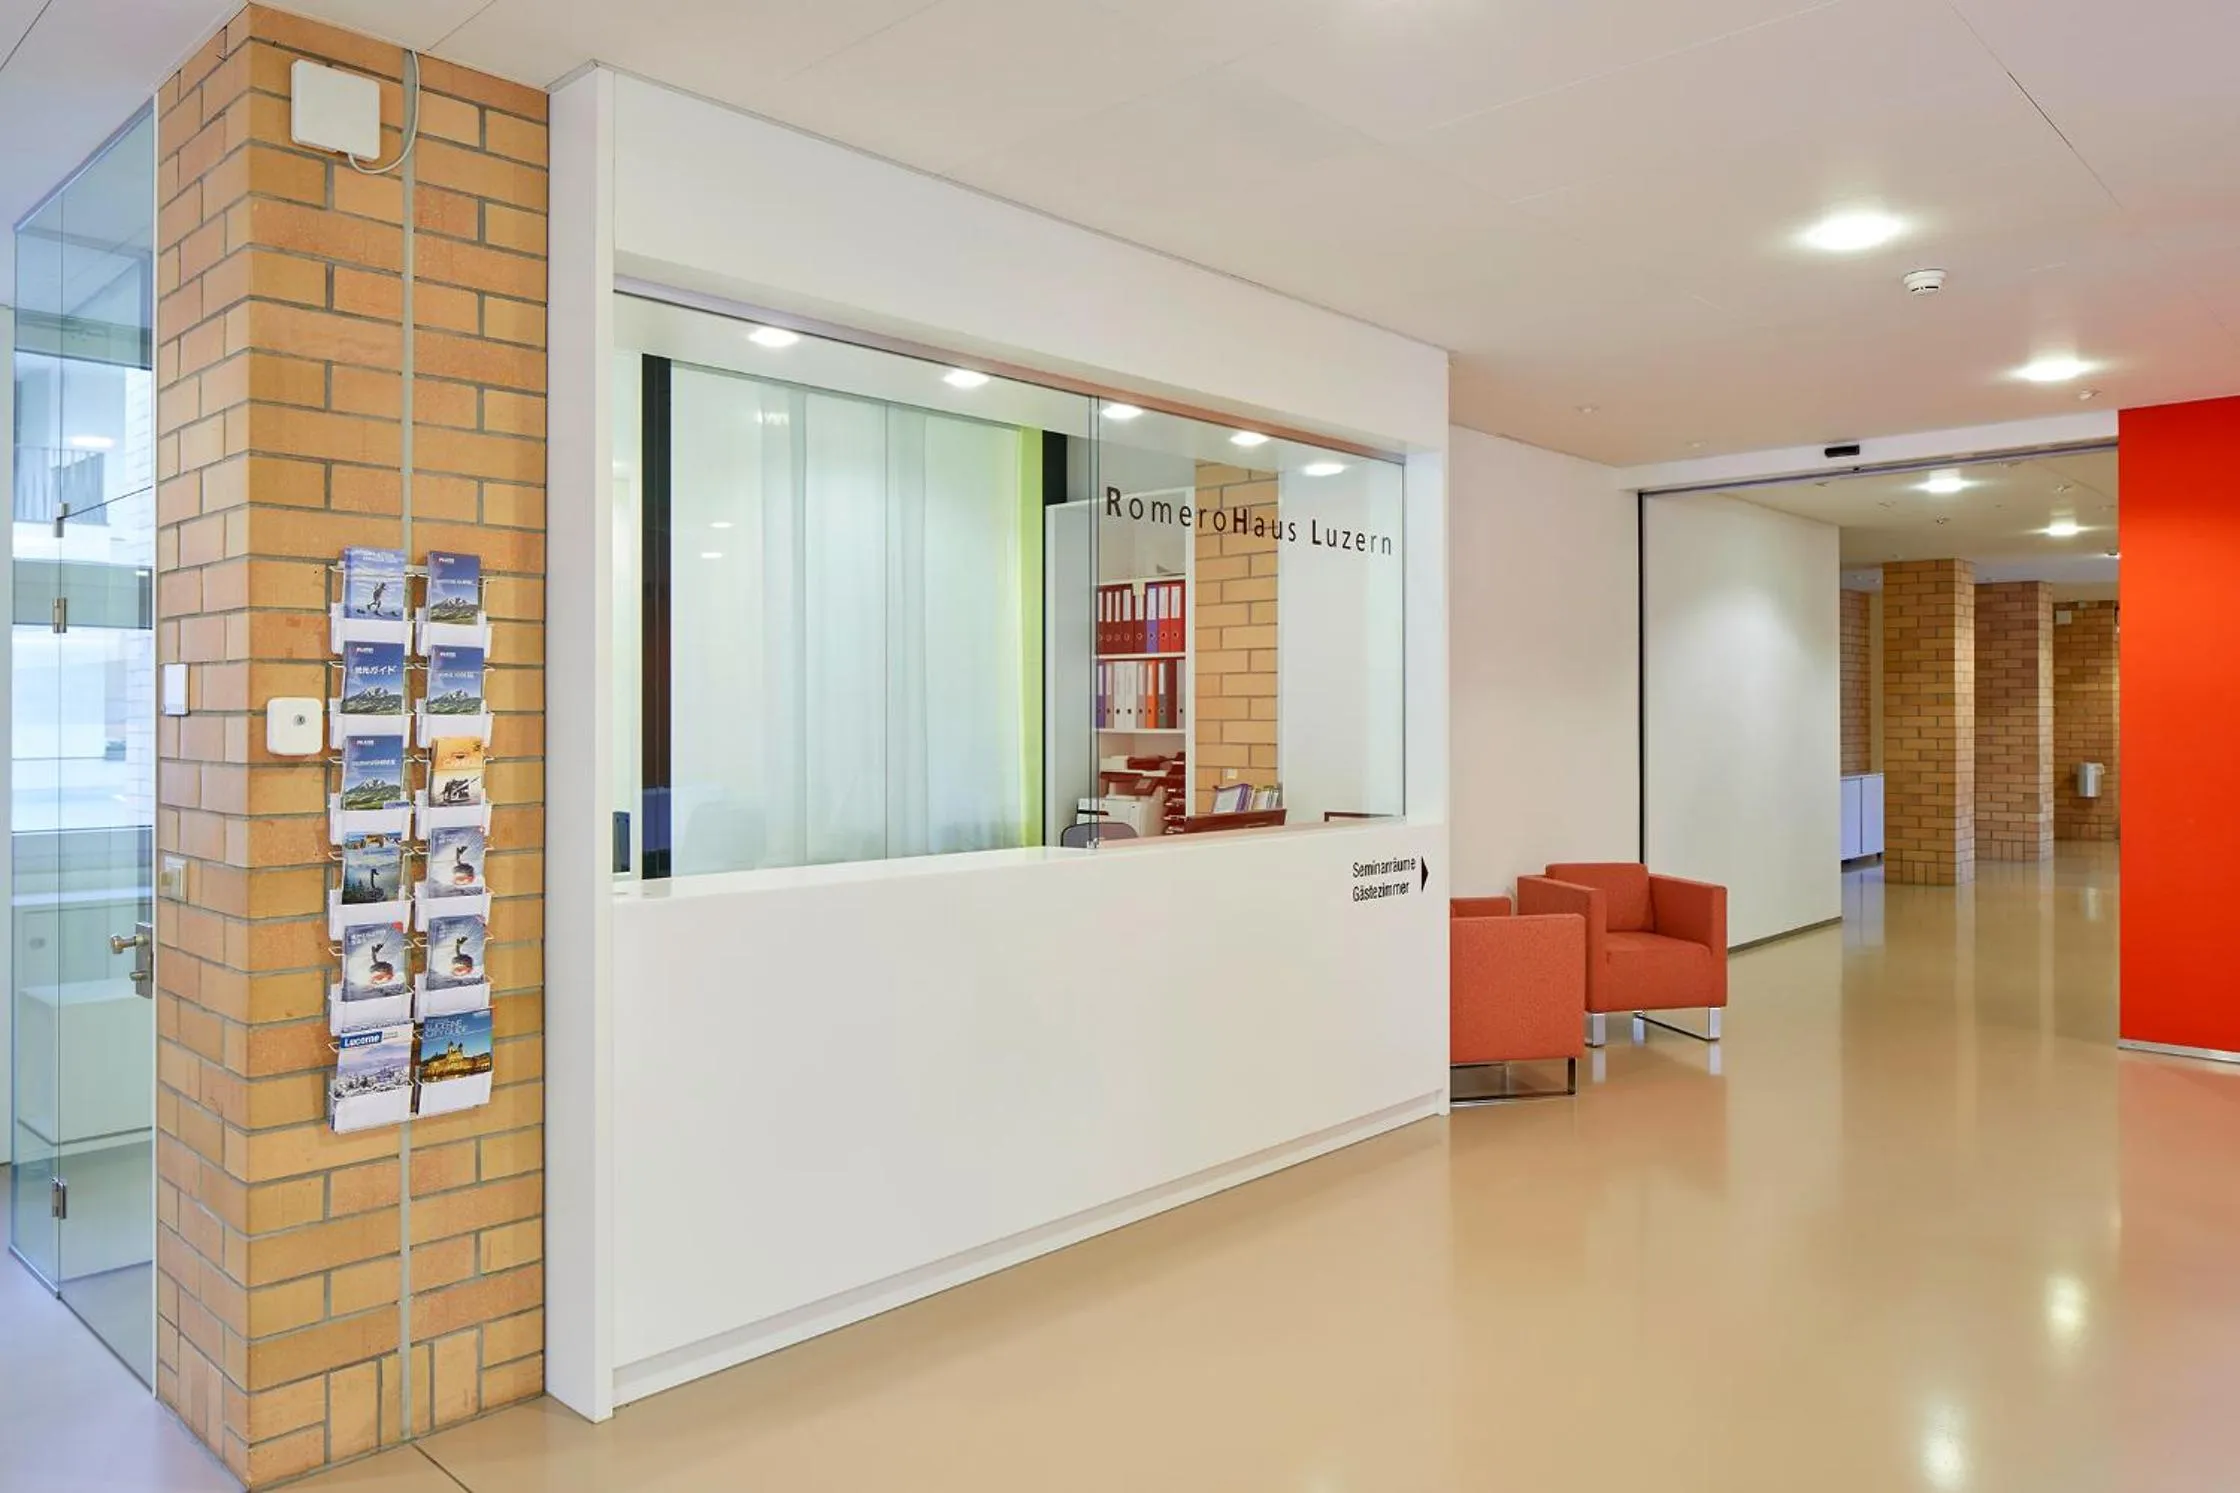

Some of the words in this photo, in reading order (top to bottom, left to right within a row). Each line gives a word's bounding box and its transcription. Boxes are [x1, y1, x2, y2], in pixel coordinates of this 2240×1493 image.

[1106, 486, 1297, 542] RomeroHaus
[1312, 519, 1391, 555] Luzern
[1353, 857, 1416, 878] Seminarräume
[1353, 882, 1410, 902] Gästezimmer
[344, 1034, 381, 1048] Lucerne
